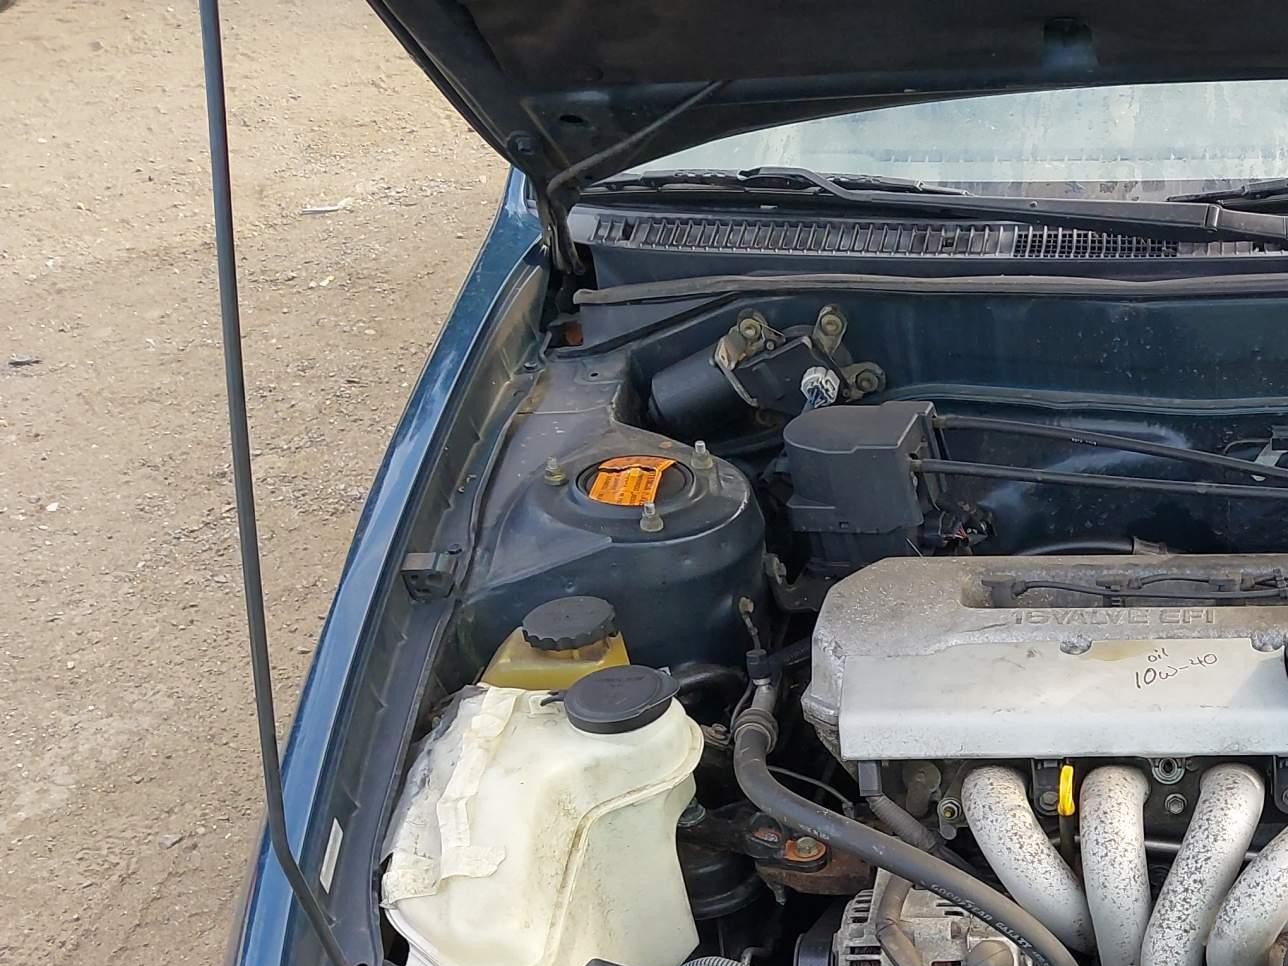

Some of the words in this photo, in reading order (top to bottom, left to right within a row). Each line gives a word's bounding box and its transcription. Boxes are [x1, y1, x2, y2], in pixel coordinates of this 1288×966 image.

[1159, 607, 1215, 625] EFI
[1147, 647, 1169, 663] oil
[930, 883, 993, 922] GOODYEAR
